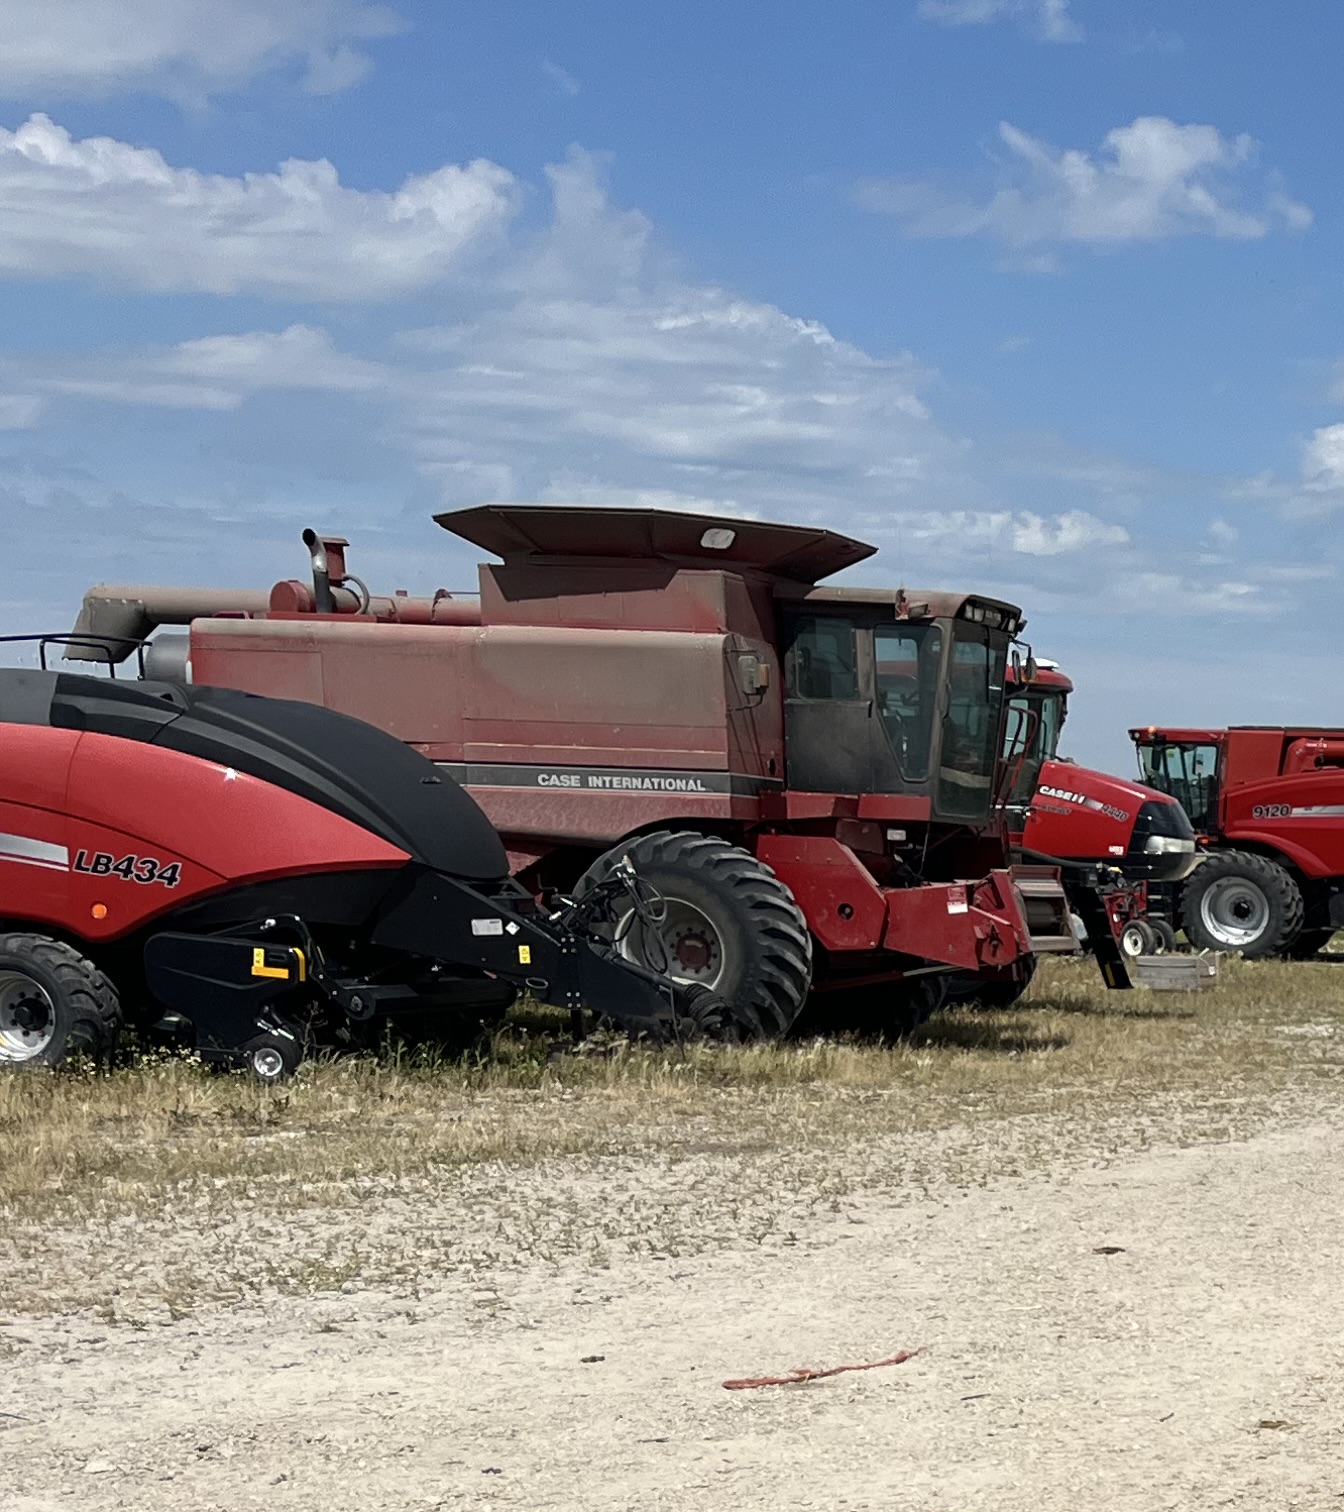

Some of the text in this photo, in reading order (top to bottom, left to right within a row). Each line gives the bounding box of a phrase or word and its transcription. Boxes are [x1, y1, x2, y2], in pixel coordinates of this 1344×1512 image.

[537, 774, 706, 791] CASE INTERNATIONAL
[1252, 804, 1291, 819] 9120
[72, 849, 182, 888] LB434
